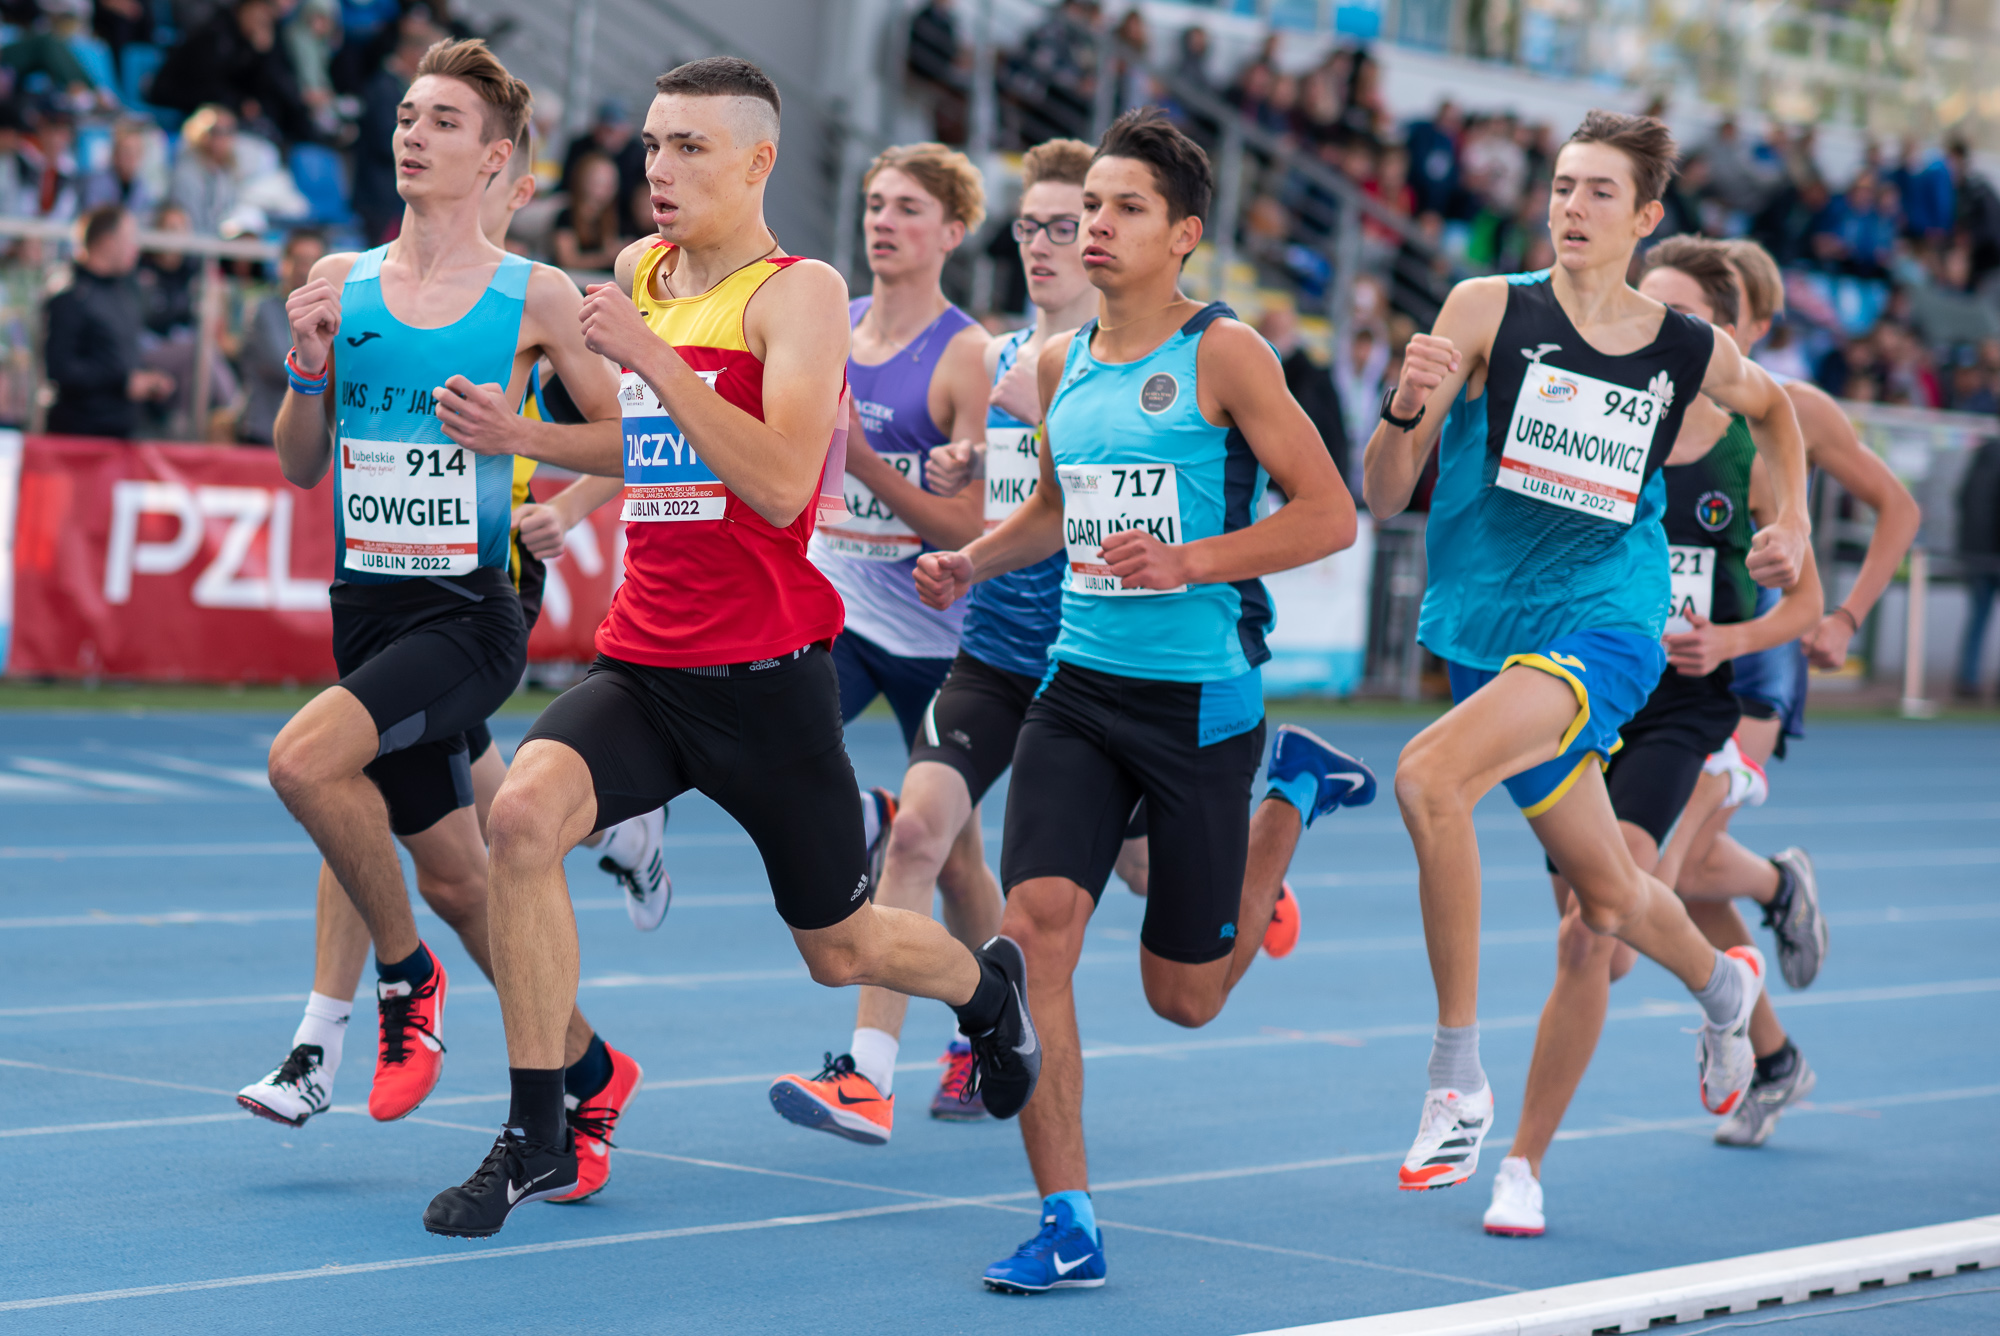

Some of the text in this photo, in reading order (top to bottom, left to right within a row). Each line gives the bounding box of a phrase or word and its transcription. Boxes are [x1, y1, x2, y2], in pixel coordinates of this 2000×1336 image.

[342, 381, 368, 408] UKS
[1547, 384, 1571, 395] LOTTO
[1604, 391, 1653, 426] 943
[1516, 415, 1645, 474] URBANOWICZ
[352, 450, 395, 463] lubelskie
[406, 448, 466, 477] 914
[1112, 468, 1166, 497] 717
[1522, 477, 1575, 502] LUBLIN
[1580, 493, 1616, 513] 2022
[347, 493, 470, 526] GOWGIEL
[630, 500, 700, 516] LUBLIN 2022
[362, 553, 451, 570] LUBLIN 2022
[867, 545, 900, 557] 2022
[1085, 576, 1115, 591] LUBLIN
[749, 660, 780, 671] adidas
